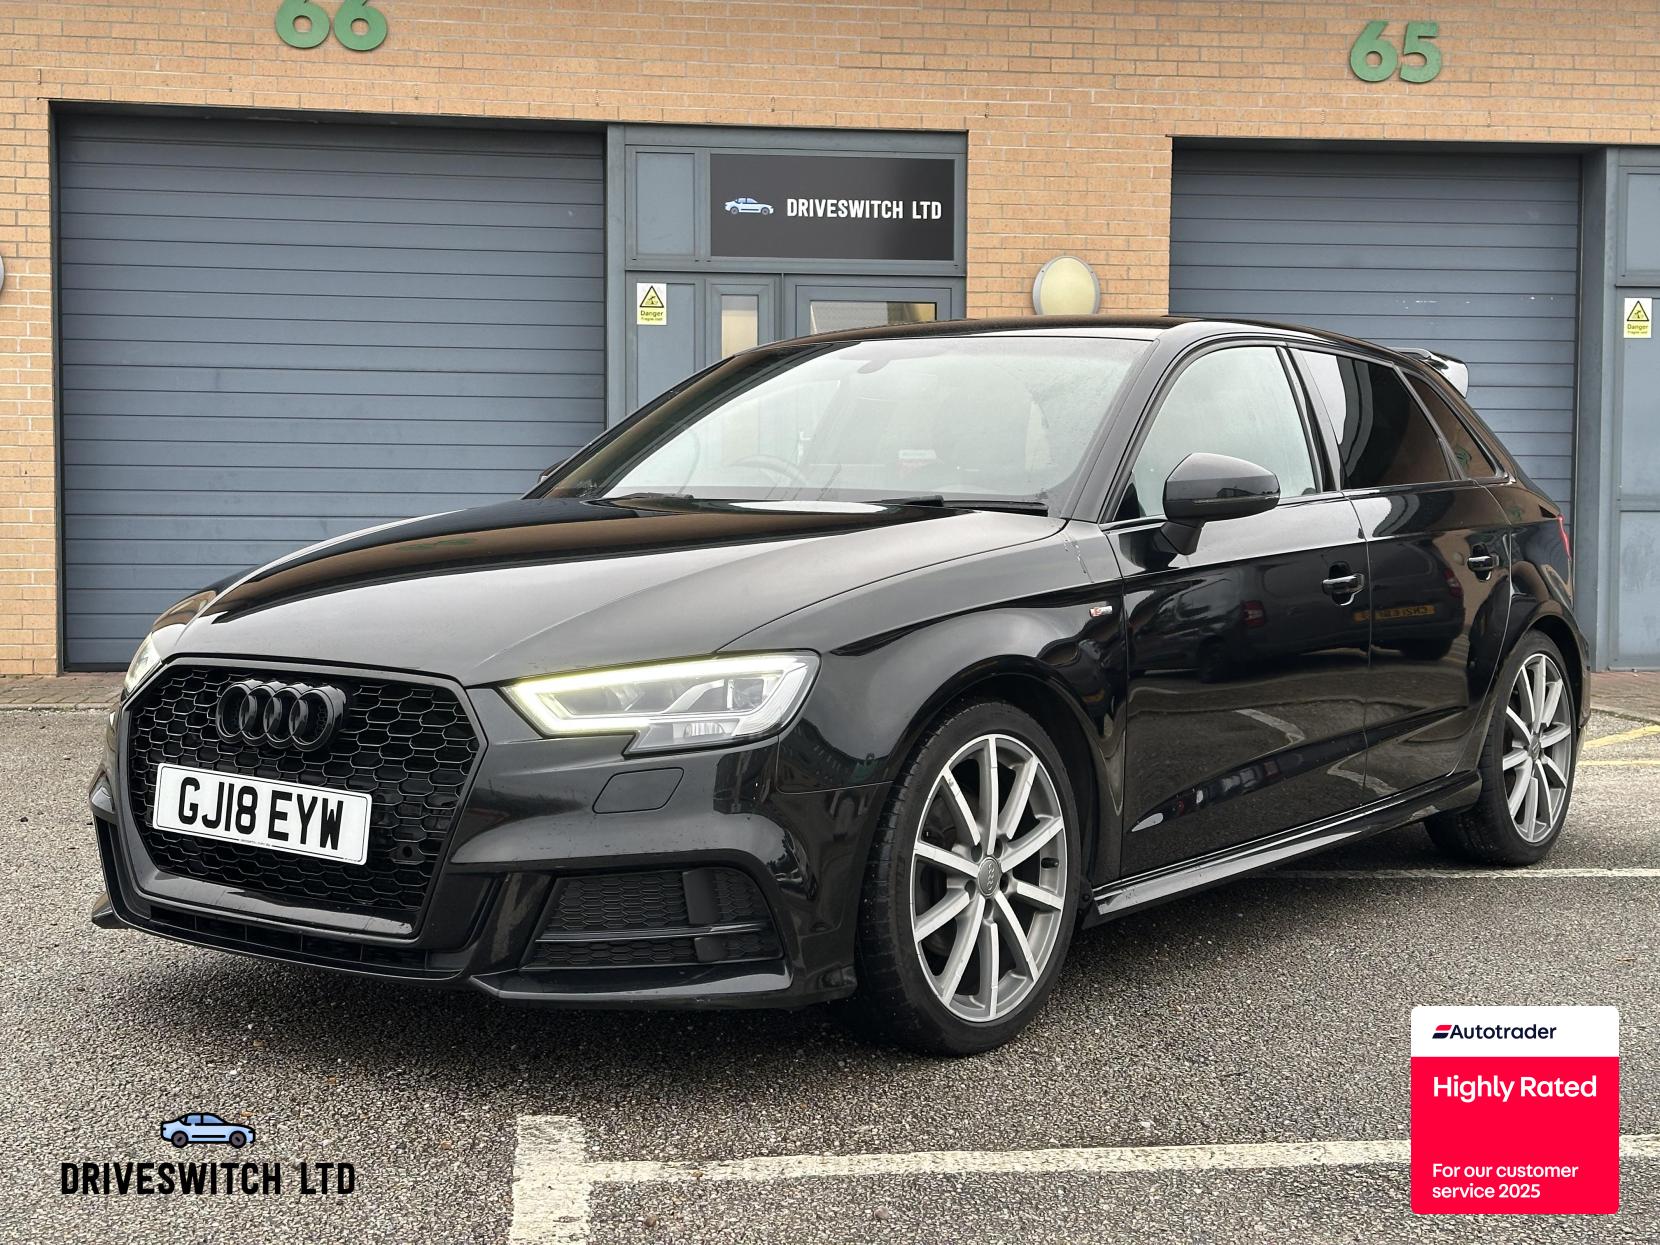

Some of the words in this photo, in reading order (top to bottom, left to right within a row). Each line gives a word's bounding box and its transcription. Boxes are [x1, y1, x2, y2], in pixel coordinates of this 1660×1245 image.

[275, 0, 388, 51] 66
[1349, 20, 1442, 83] 65
[786, 198, 904, 220] DRIVESWITCH
[912, 201, 942, 220] LTD
[640, 310, 663, 318] Danger
[178, 776, 259, 836] GJ18
[267, 789, 344, 850] EYW
